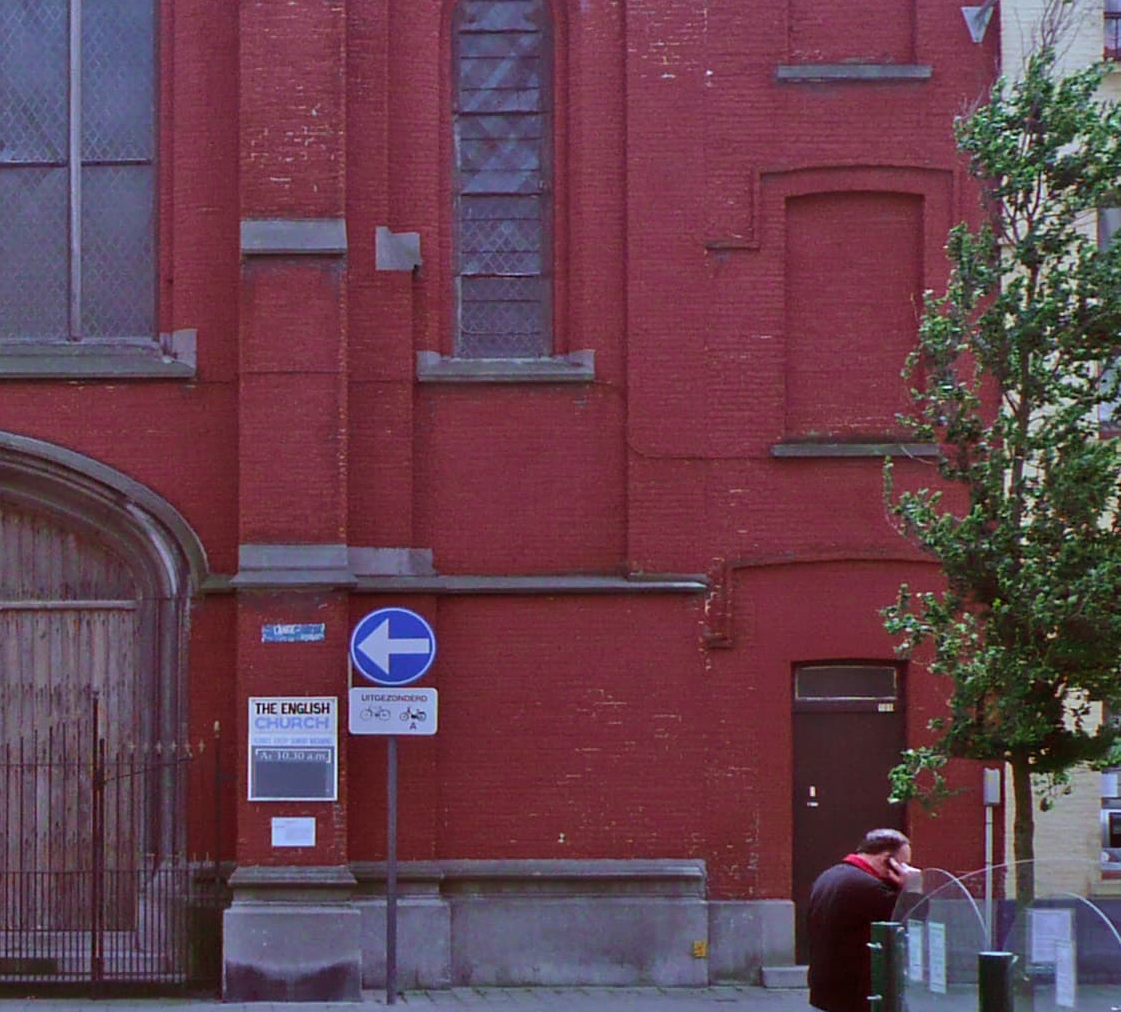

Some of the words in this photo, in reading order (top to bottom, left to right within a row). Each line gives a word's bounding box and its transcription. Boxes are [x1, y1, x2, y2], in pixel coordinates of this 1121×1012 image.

[361, 694, 428, 702] UITGEZONDERD
[255, 702, 278, 714] THE
[281, 702, 331, 714] ENGLISH
[255, 716, 329, 729] CHURCH
[409, 721, 417, 730] A
